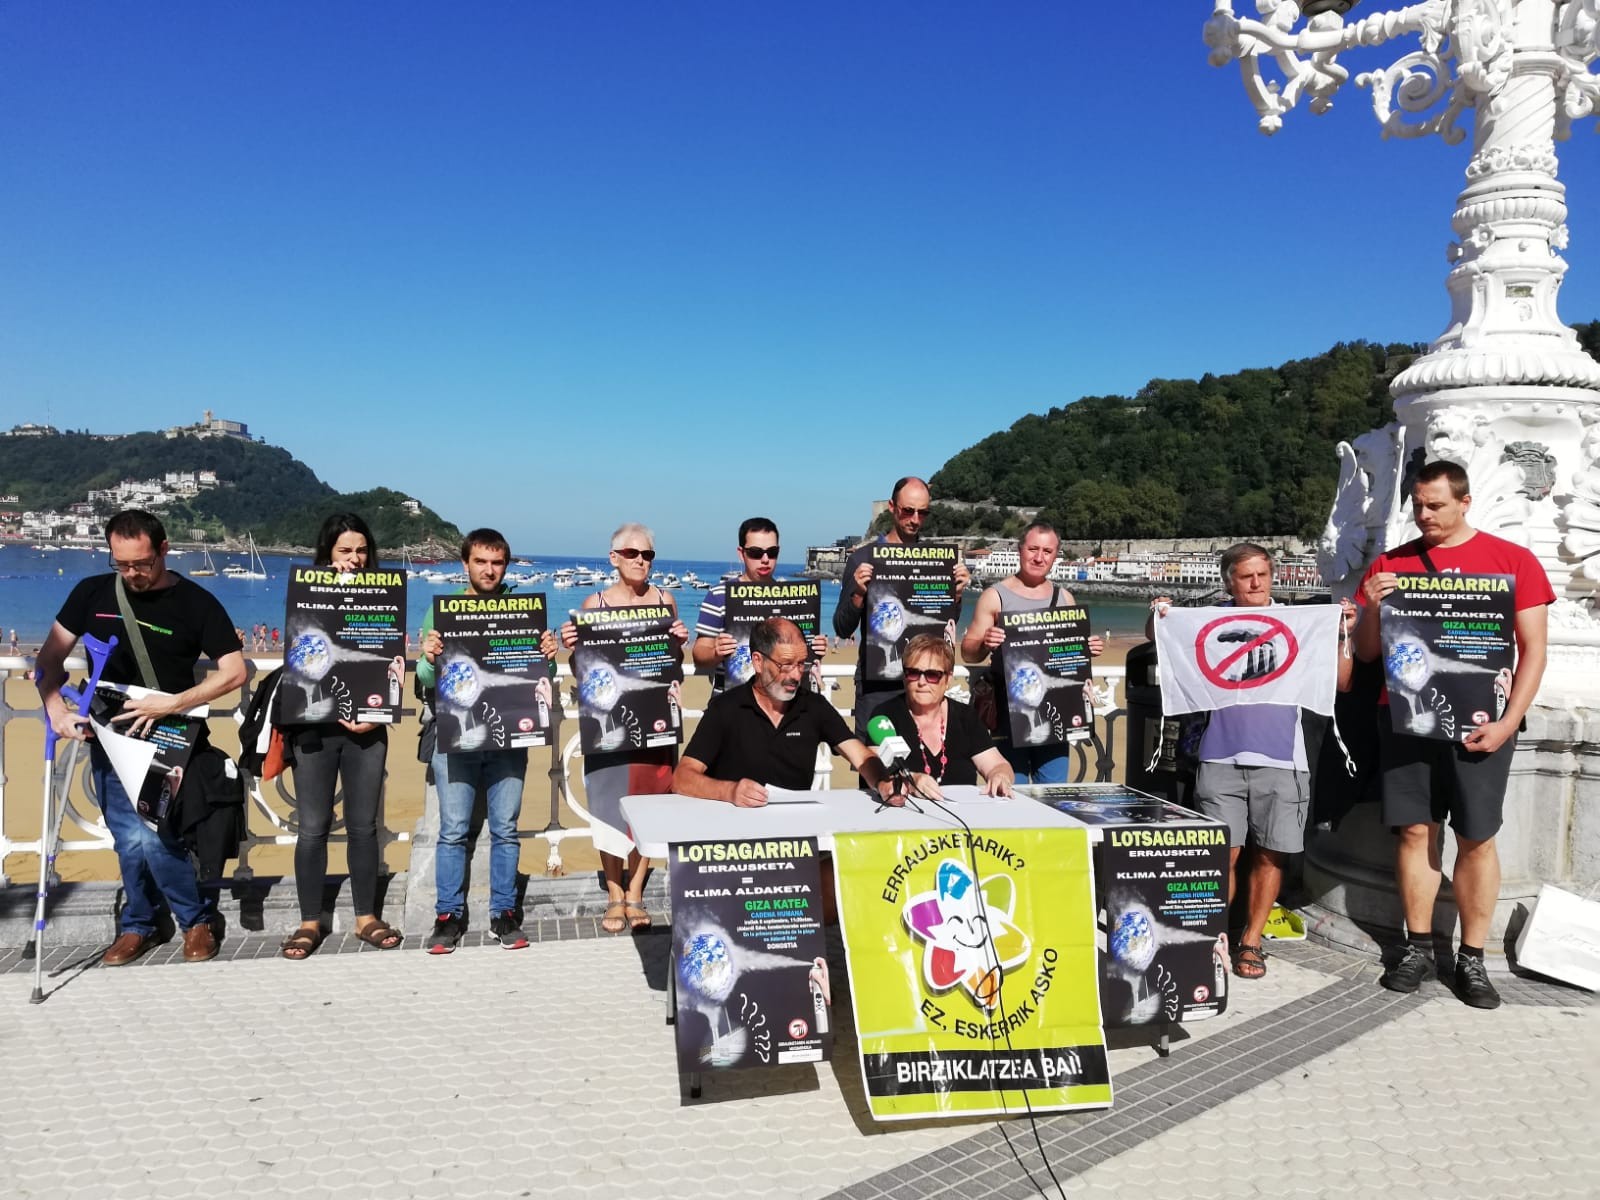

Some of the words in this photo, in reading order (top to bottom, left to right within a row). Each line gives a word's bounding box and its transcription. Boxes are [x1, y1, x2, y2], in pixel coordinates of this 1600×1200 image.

[873, 547, 955, 559] LOTSAGARRIA
[1398, 576, 1509, 592] OTSAGARRIA
[730, 584, 818, 598] LOTSAGARRIA
[440, 598, 542, 612] LOTSAGARRIA
[576, 608, 670, 625] LOTSAGARRIA
[1004, 609, 1087, 626] LOTSAGARRIA
[1435, 611, 1504, 619] ALDAKETA
[592, 620, 659, 631] ERRAUSKETA
[1469, 622, 1500, 631] KATEA
[619, 634, 670, 643] ALDAKETA
[645, 643, 669, 651] KATEA
[1112, 830, 1226, 847] LOTSAGARRIA
[678, 840, 813, 862] LOTSAGARRIA
[698, 862, 795, 873] ERRAUSKETA
[882, 833, 1025, 903] ERRAUSKETARIK?
[1160, 870, 1222, 878] ALDAKETA
[684, 888, 731, 897] KLIMA
[735, 885, 811, 895] ALDAKETA
[1167, 883, 1188, 892] GIZA
[1190, 882, 1219, 890] KATEA
[745, 901, 770, 910] GIZA
[773, 898, 809, 909] KATEA
[921, 999, 946, 1031] EZ,
[955, 1000, 1035, 1040] ESKERRIK
[1030, 948, 1058, 1005] ASKO
[896, 1059, 1037, 1083] BIRZIKLATZEA
[1042, 1055, 1083, 1077] BAI!
